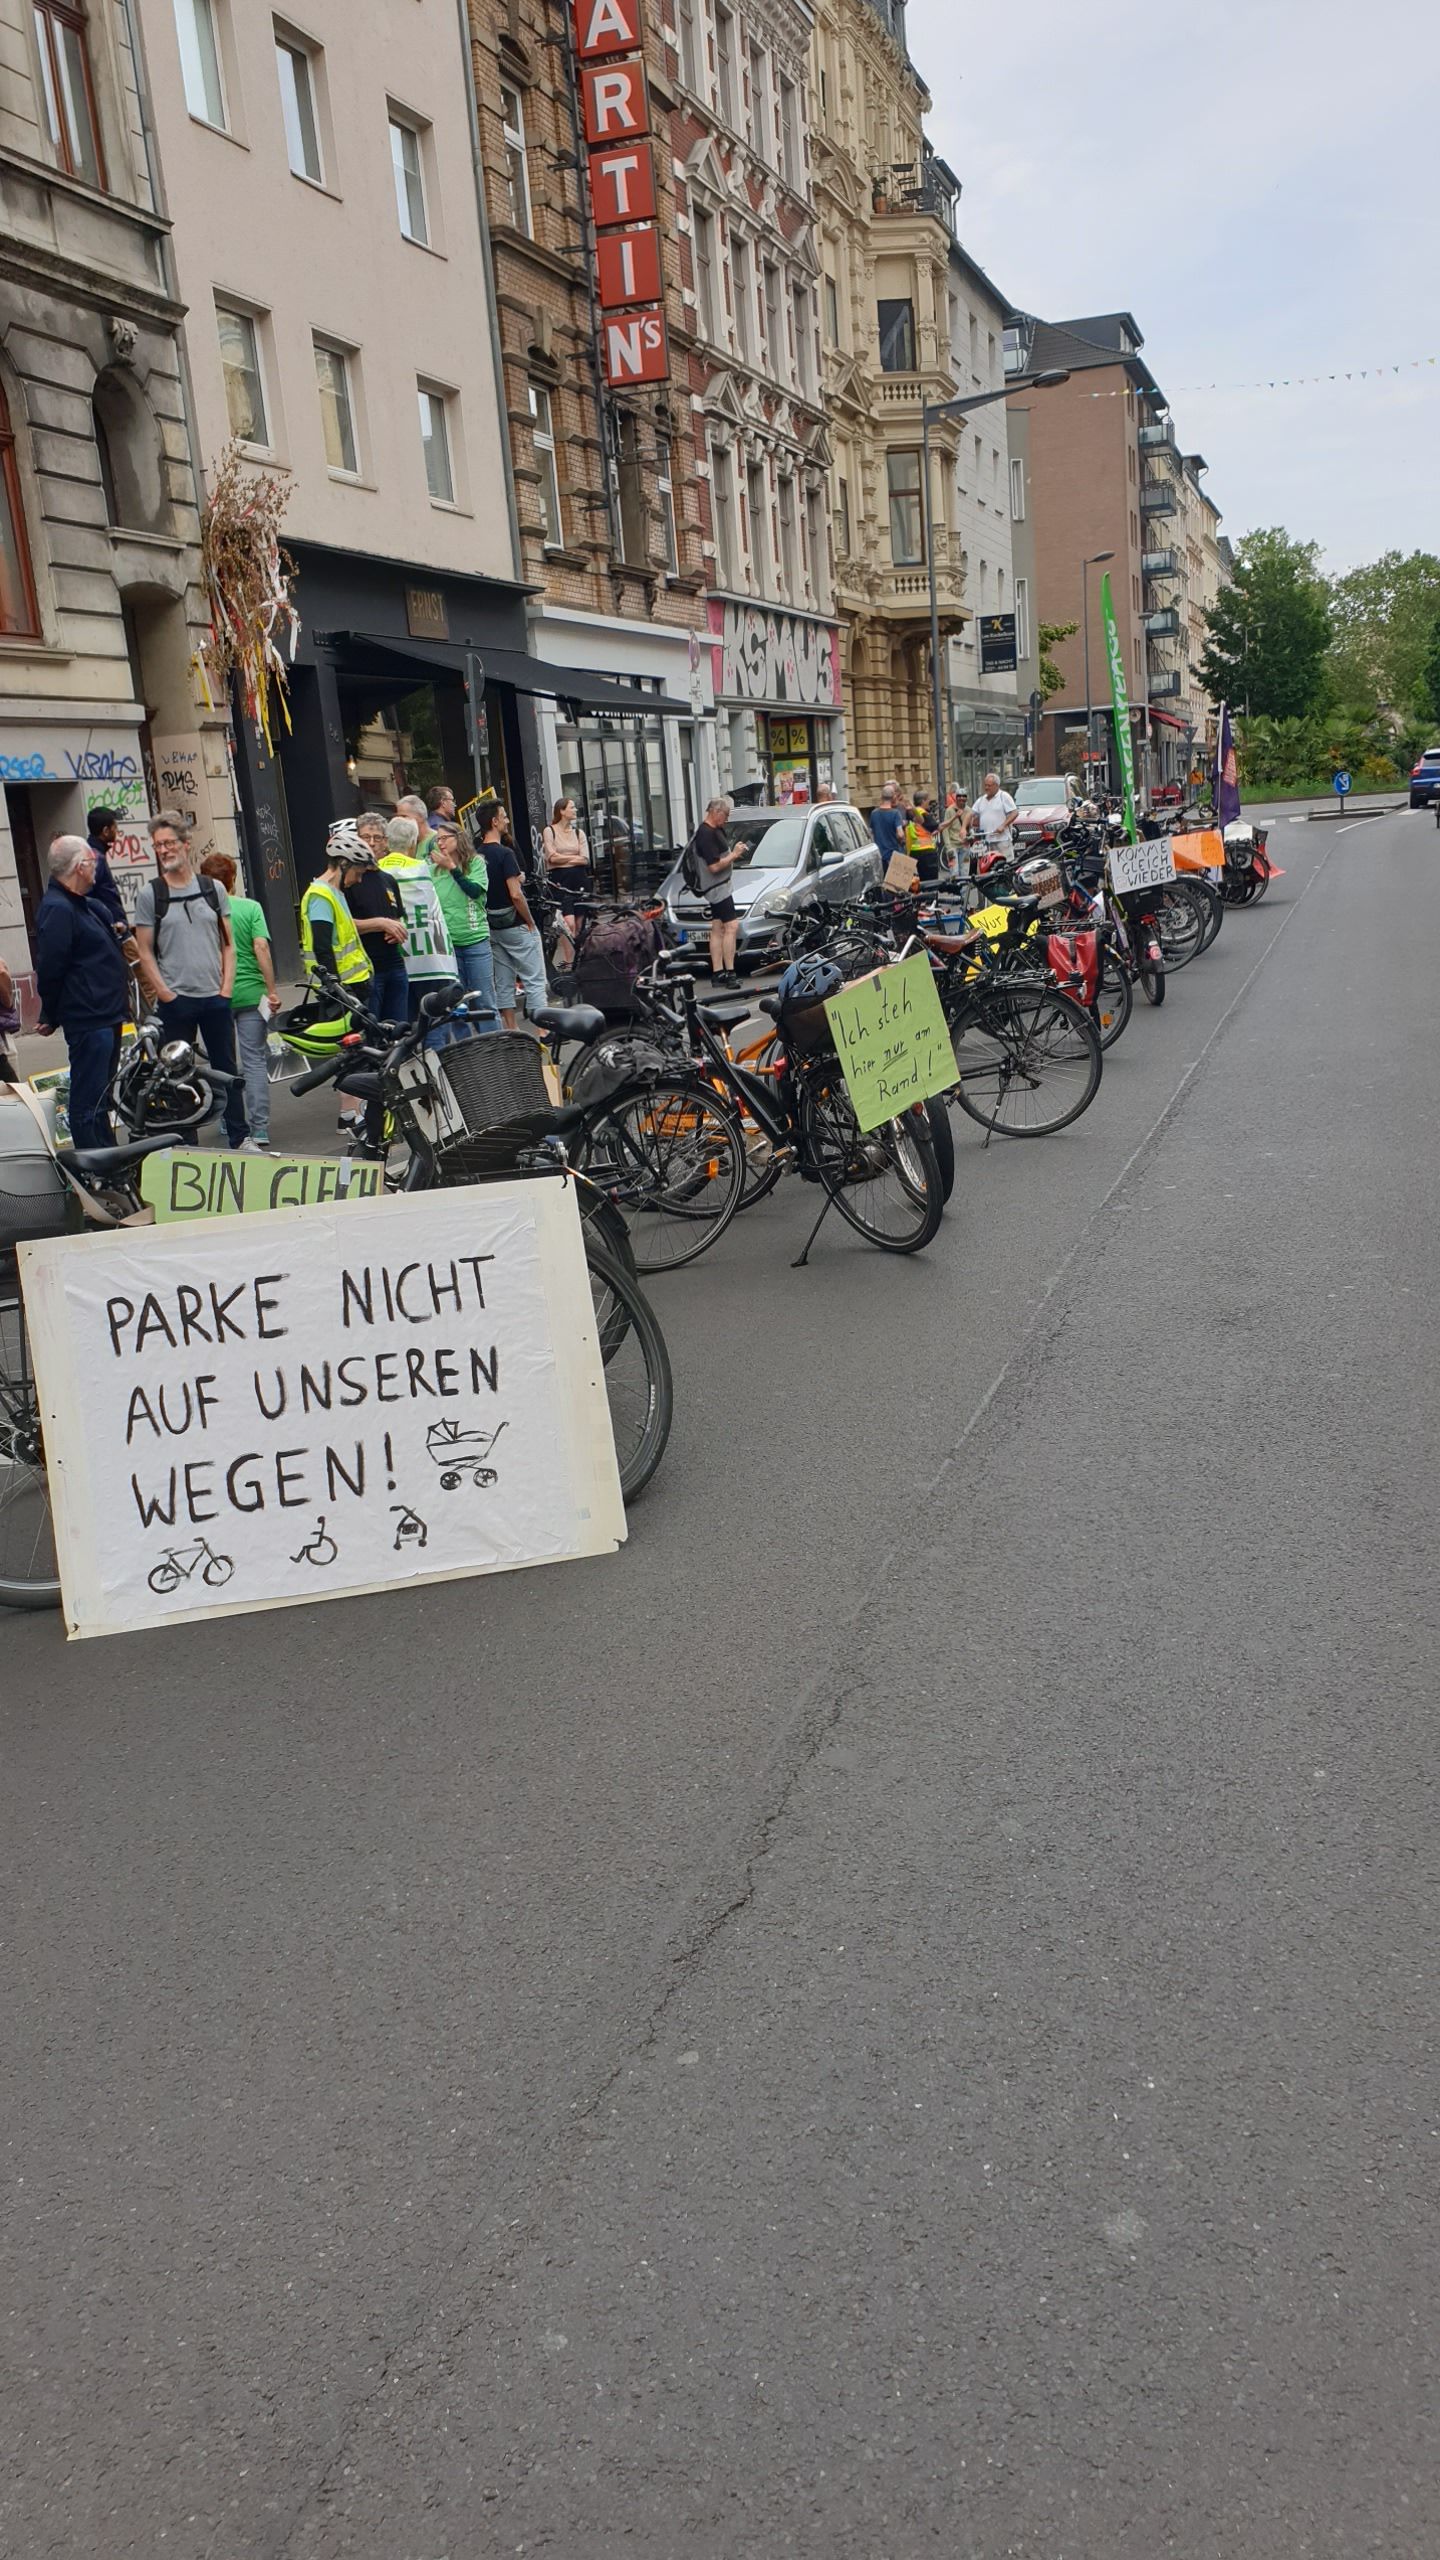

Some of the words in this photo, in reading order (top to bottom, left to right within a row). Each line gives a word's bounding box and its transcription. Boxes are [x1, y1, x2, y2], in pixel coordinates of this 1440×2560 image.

[1117, 840, 1167, 862] KOMME
[1122, 855, 1168, 875] GLEICH
[1128, 866, 1173, 887] WIEDER
[977, 915, 1002, 931] Nur
[878, 977, 912, 1030] steh
[851, 1055, 876, 1079] hier
[883, 1041, 905, 1061] nur
[915, 1027, 931, 1041] am
[170, 1161, 246, 1213] BIN
[106, 1274, 290, 1357] PARKE
[342, 1254, 496, 1328] NICHT
[126, 1375, 220, 1445] AUF
[254, 1346, 499, 1421] UNSEREN
[131, 1432, 396, 1529] WEGEN!
